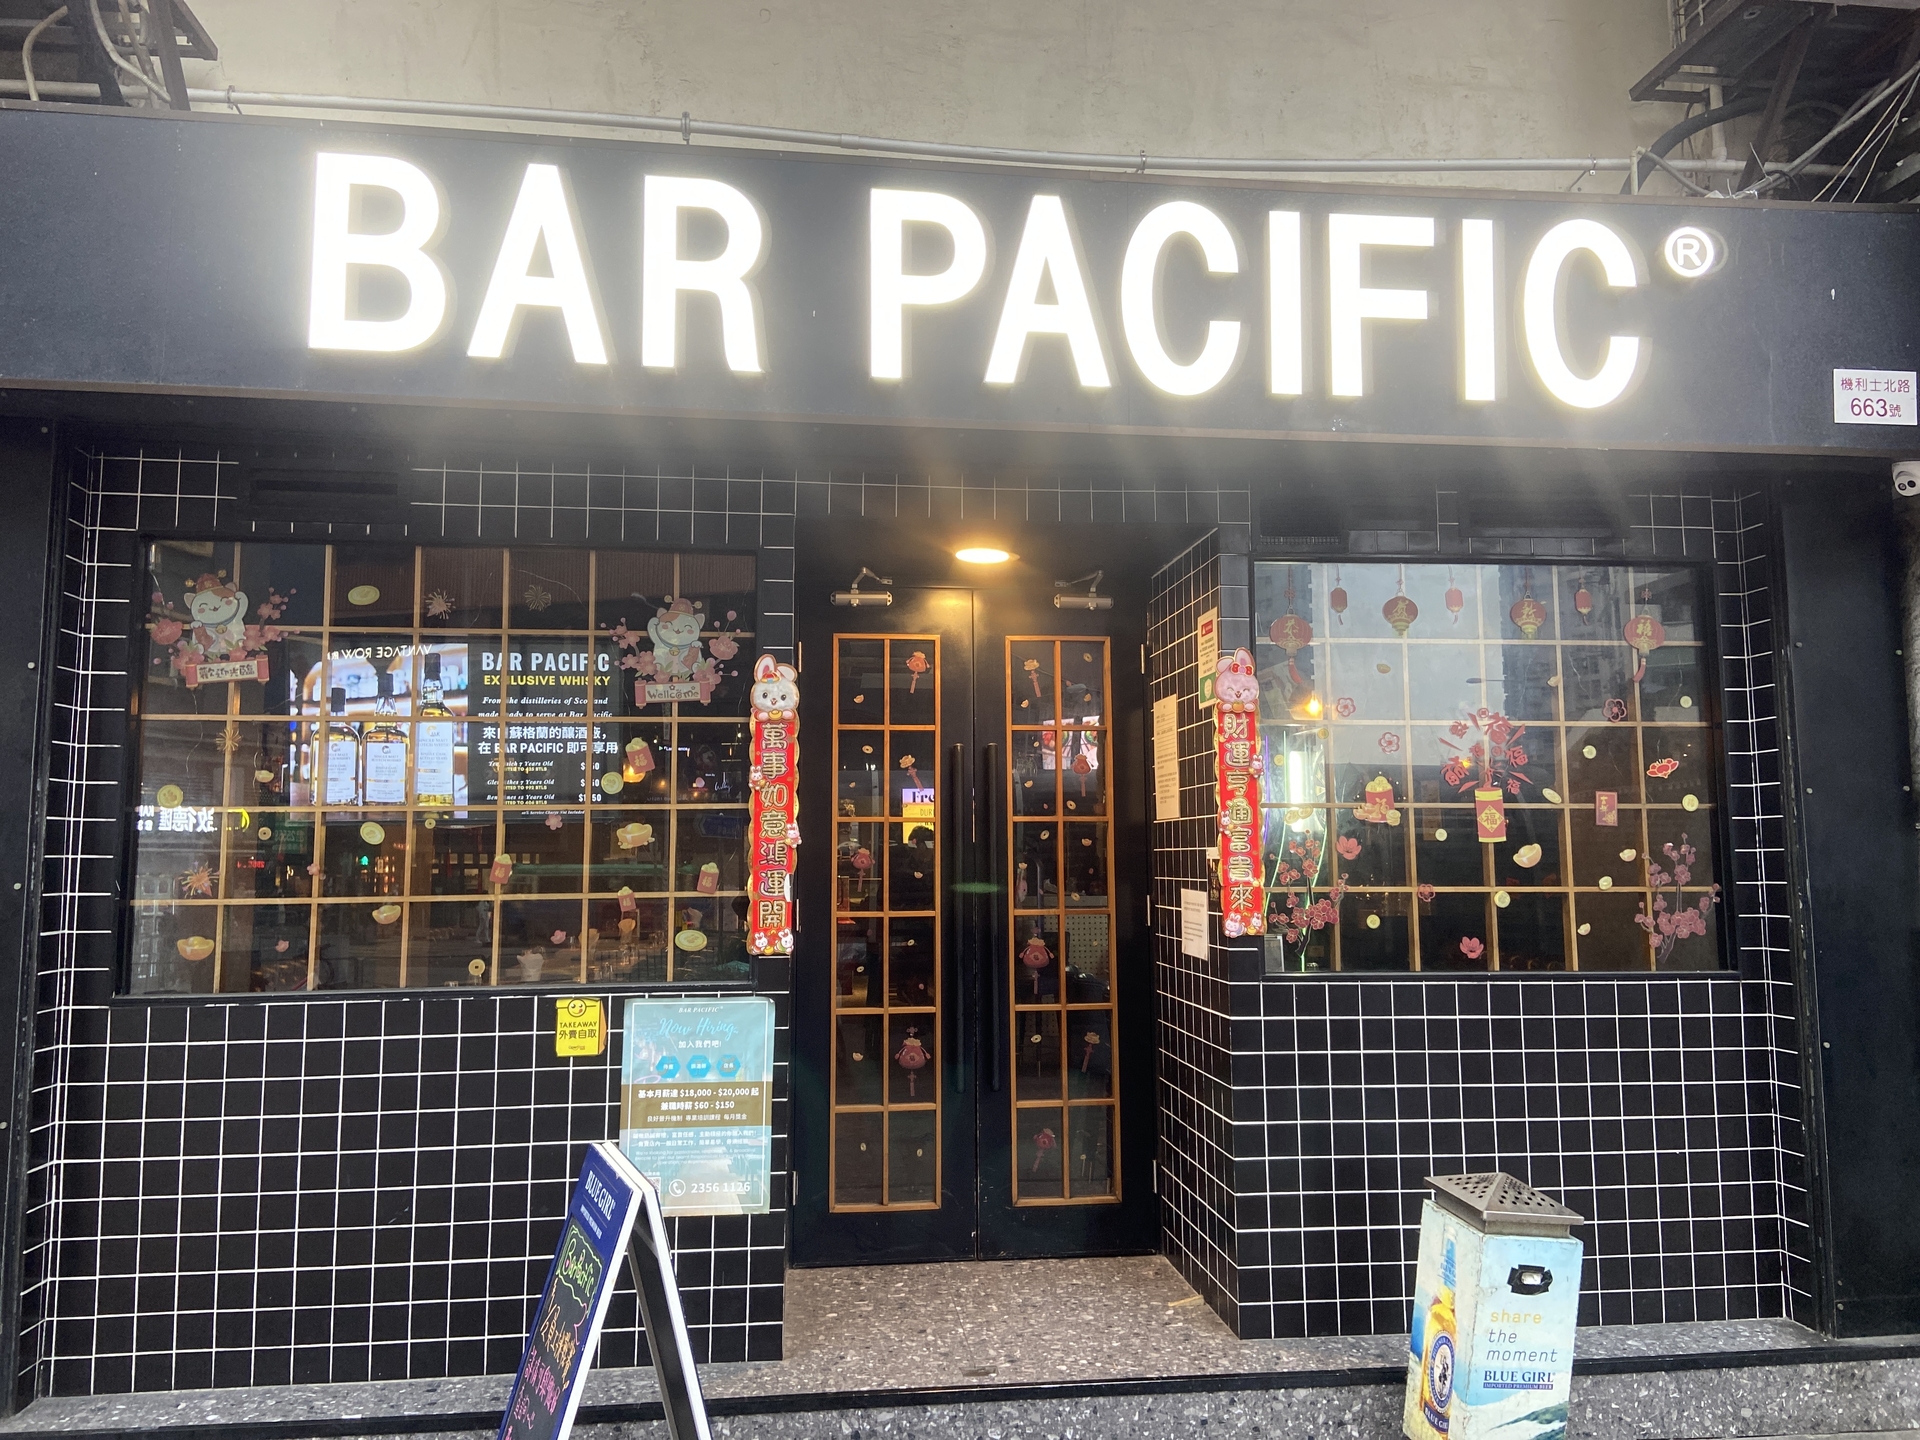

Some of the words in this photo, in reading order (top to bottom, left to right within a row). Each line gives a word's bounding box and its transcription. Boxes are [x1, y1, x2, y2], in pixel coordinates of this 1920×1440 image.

[308, 151, 764, 373] BAR
[870, 187, 1642, 409] PACIFIC
[1840, 377, 1910, 393] 機利士北路
[482, 652, 523, 671] BAR
[532, 652, 610, 672] PACIFC
[484, 675, 556, 686] EXLUSIVE
[521, 697, 561, 705] distilleries
[573, 697, 608, 705] Scoand
[478, 742, 492, 755] 在
[520, 743, 564, 754] PACIFIC
[578, 793, 602, 802] $150
[1223, 712, 1253, 911] 財運亨通富貴來
[759, 723, 788, 928] 萬事如意鴻運開
[559, 1021, 598, 1029] TAKEAWAY
[659, 1018, 692, 1039] Now
[558, 1029, 597, 1040] 外賣自取
[679, 1088, 712, 1098] $18,000
[718, 1087, 750, 1098] $20,000
[750, 1087, 760, 1097] 起
[694, 1101, 709, 1110] $60
[715, 1100, 735, 1109] $150
[690, 1183, 720, 1194] 2356
[722, 1182, 751, 1193] 1126
[1490, 1309, 1542, 1324] share
[1488, 1328, 1517, 1344] the
[1486, 1348, 1558, 1363] moment
[1483, 1370, 1518, 1382] BLUE
[1521, 1371, 1554, 1383] GIRL
